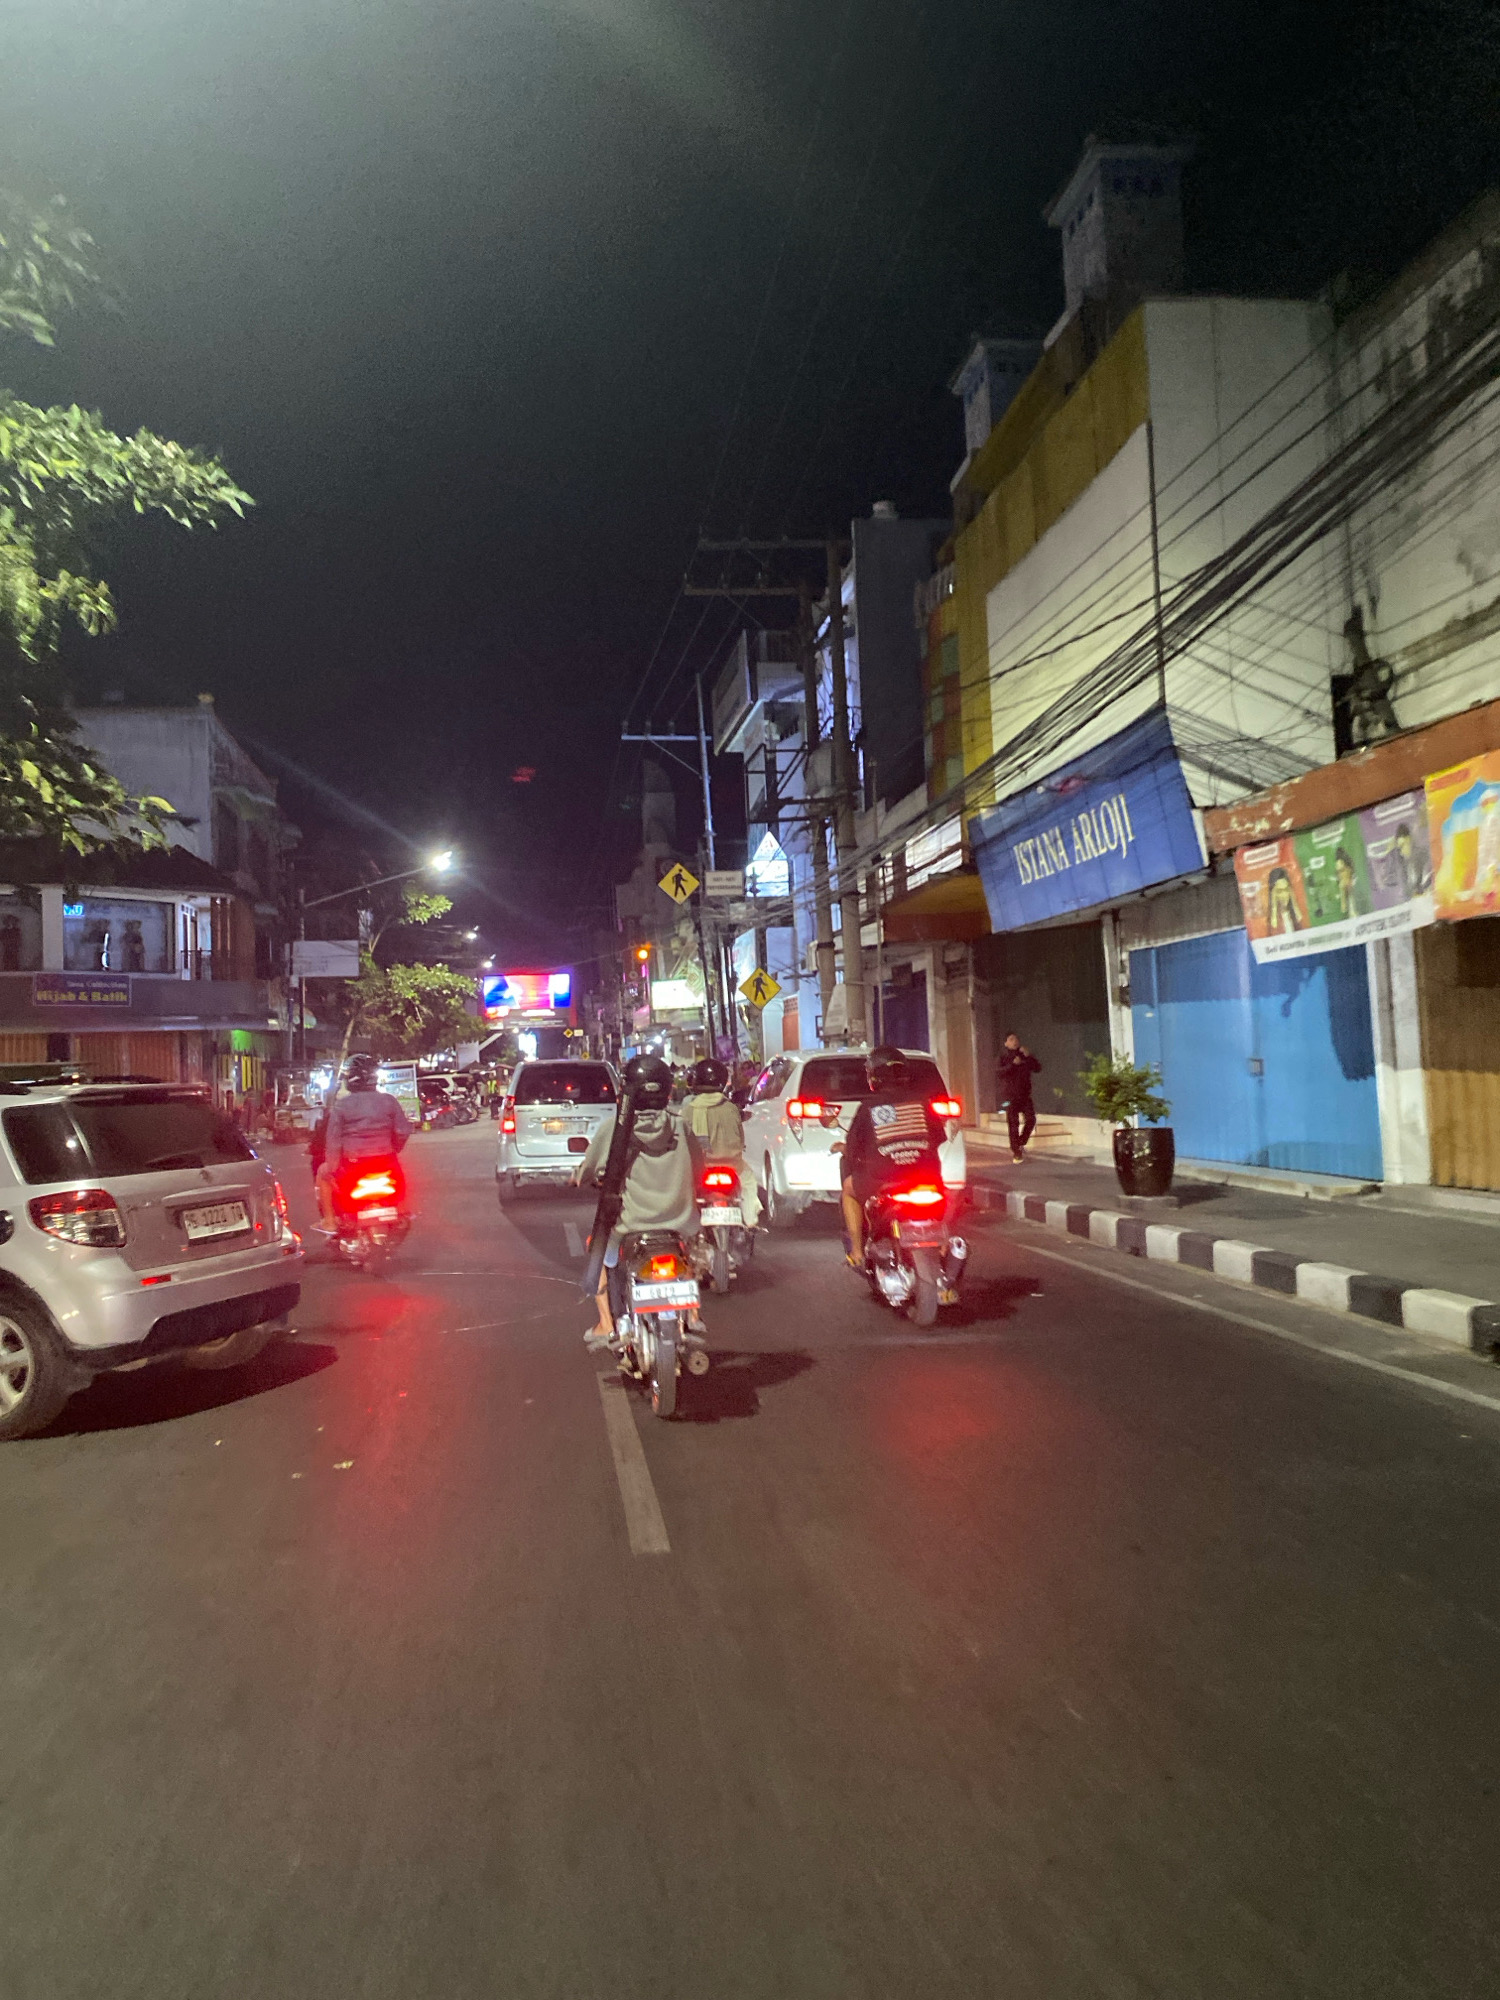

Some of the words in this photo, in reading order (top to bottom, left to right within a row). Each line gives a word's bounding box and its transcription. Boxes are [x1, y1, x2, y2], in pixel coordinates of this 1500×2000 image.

[1013, 825, 1071, 885] ISTANA
[1071, 793, 1136, 865] ARLOJI
[78, 991, 88, 1001] &
[91, 991, 127, 1001] Batik
[635, 1289, 641, 1298] N
